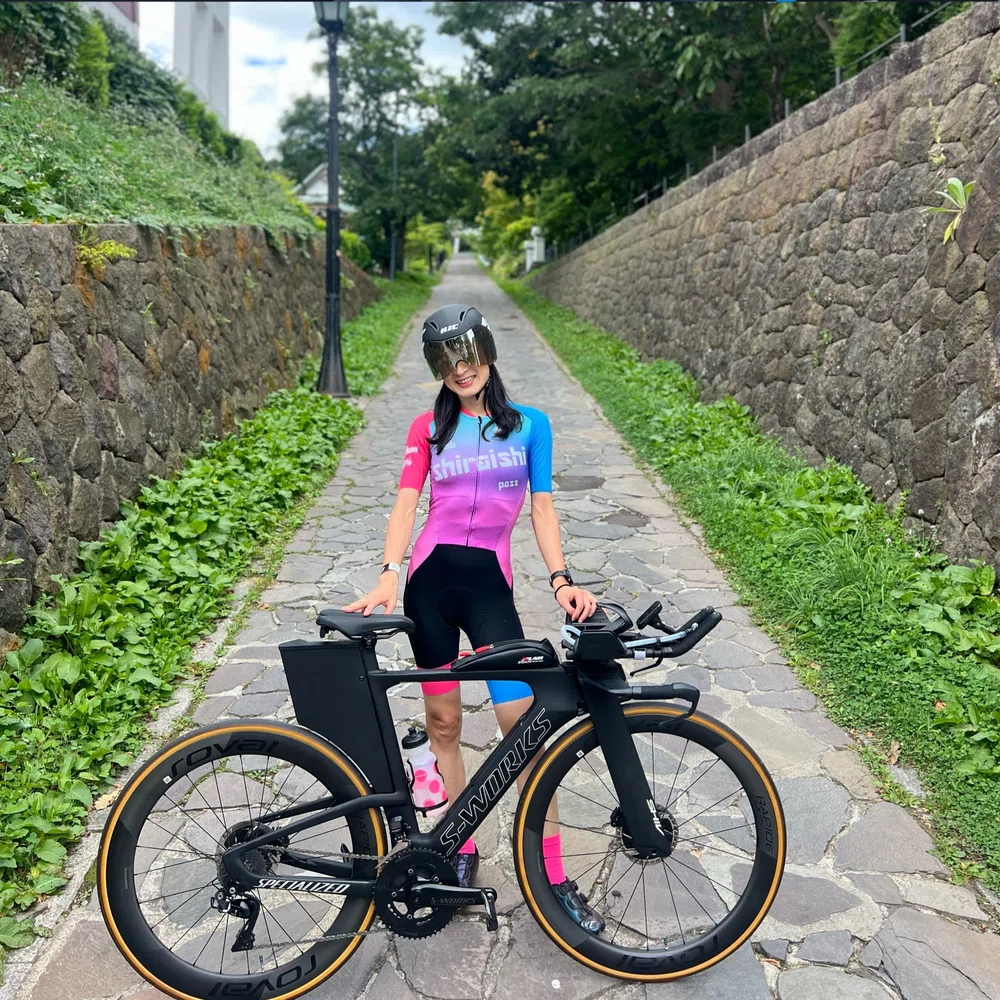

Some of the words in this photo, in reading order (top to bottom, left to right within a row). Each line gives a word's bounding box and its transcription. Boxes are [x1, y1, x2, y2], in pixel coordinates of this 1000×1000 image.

[433, 446, 527, 482] shiraishi
[498, 478, 519, 490] pass
[440, 708, 552, 857] S-WORKS
[256, 878, 351, 894] SPECIALIZED
[208, 954, 317, 997] roval
